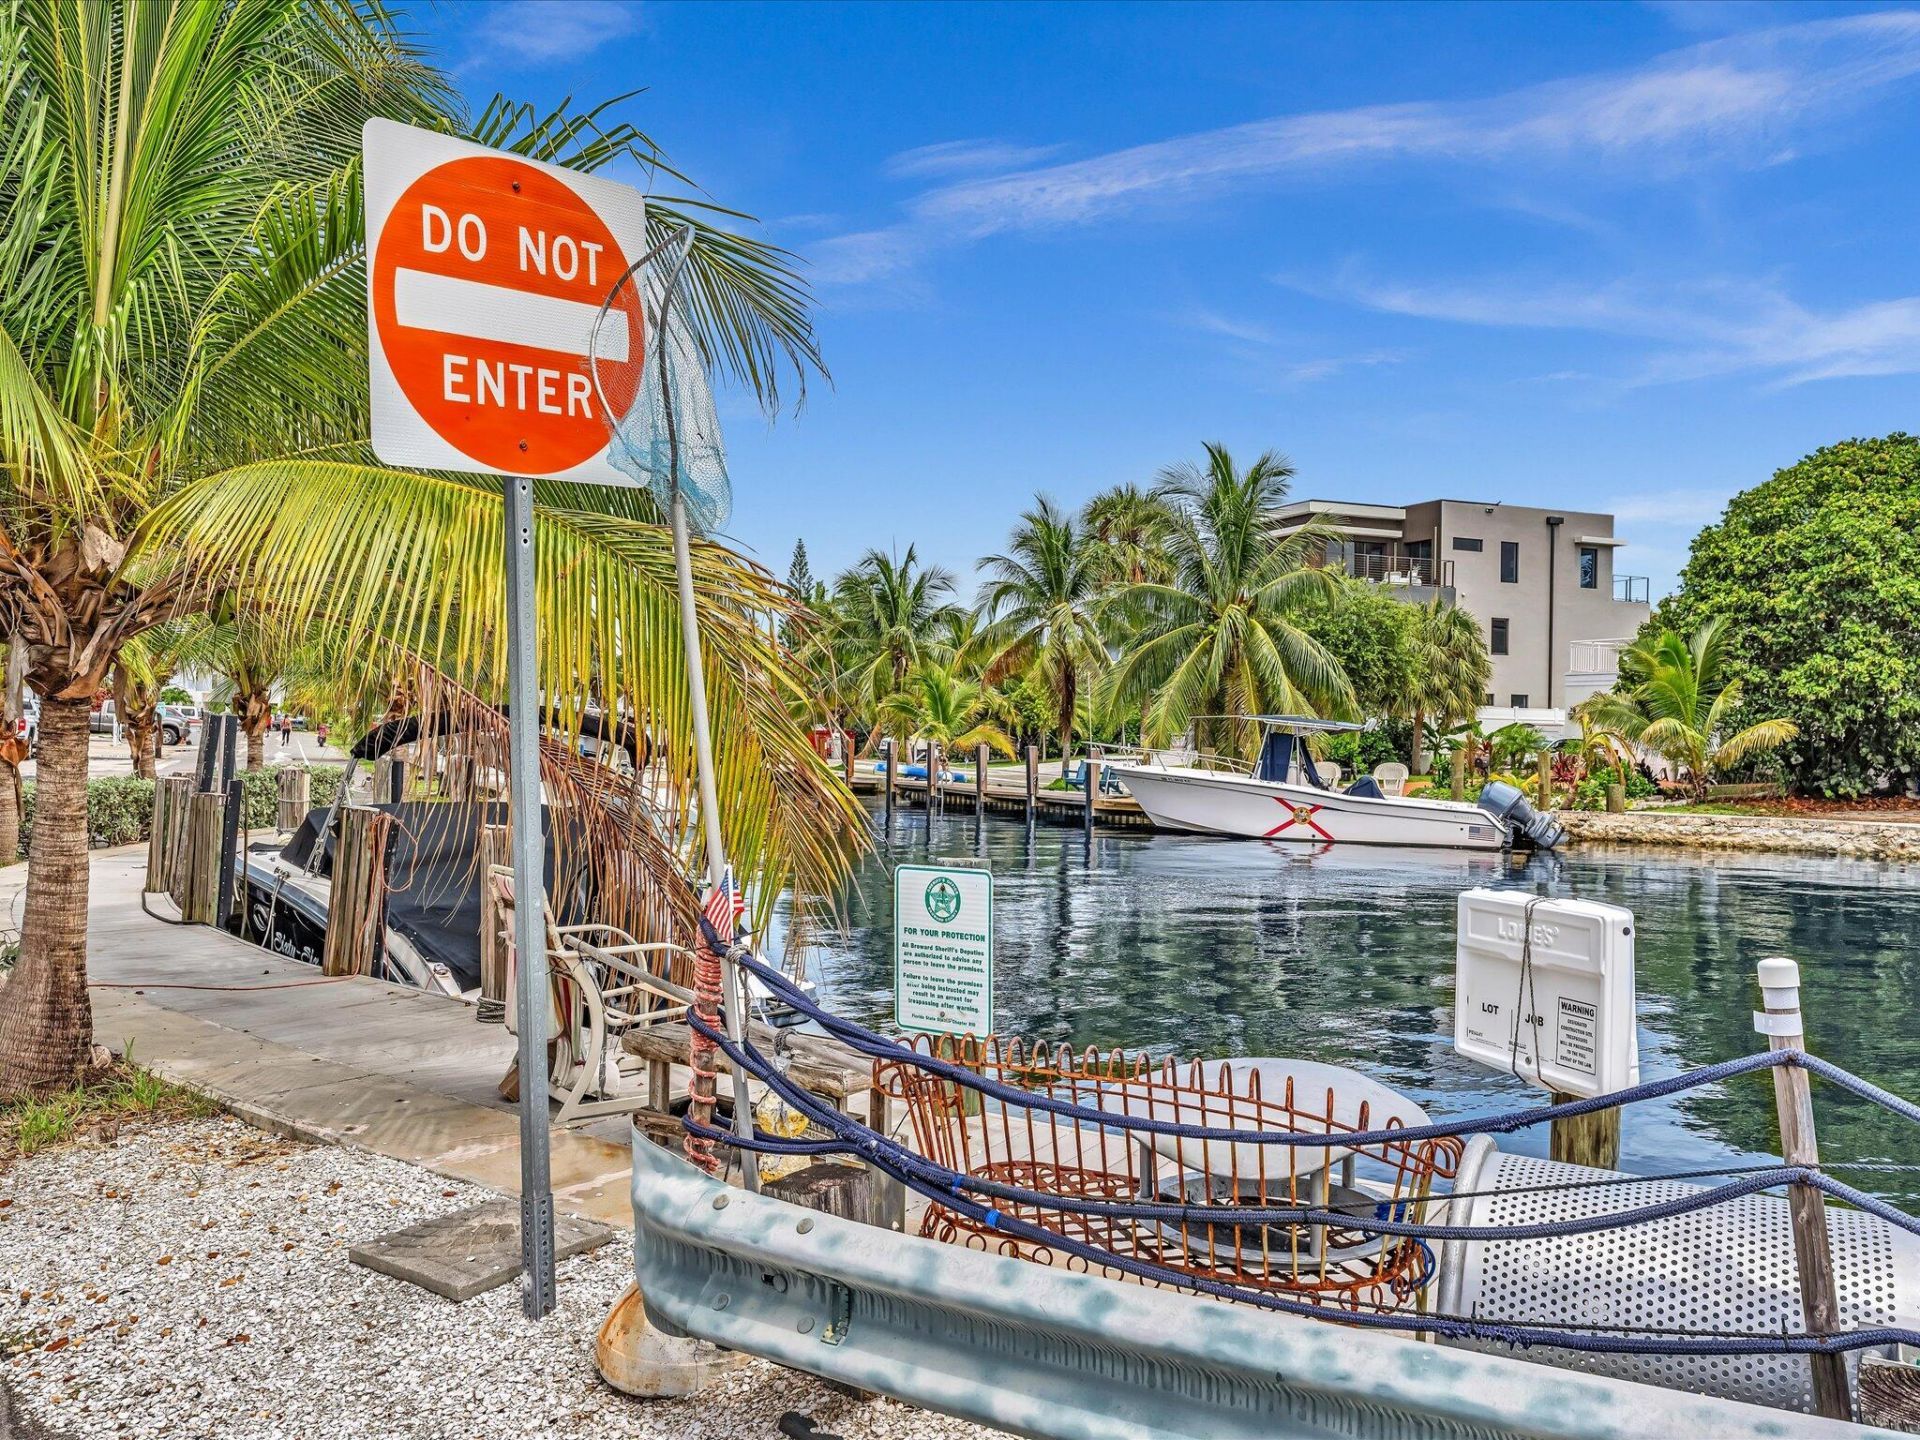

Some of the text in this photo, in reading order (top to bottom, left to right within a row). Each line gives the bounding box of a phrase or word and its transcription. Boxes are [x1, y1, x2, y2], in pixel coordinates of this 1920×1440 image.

[421, 203, 604, 287] DO NOT
[442, 353, 594, 419] ENTER
[904, 926, 986, 942] FOR YOUR PROTECTION
[910, 942, 934, 951] Broward
[935, 946, 958, 954] Sheriff's
[960, 948, 984, 956] Deputies
[914, 952, 942, 960] authorized
[952, 956, 970, 964] advise
[972, 958, 982, 966] any
[958, 965, 985, 974] premises.
[902, 972, 921, 980] Failure
[958, 980, 983, 988] premises
[921, 983, 936, 991] being
[938, 985, 966, 994] instructed
[908, 997, 940, 1008] trespassing
[940, 1002, 954, 1010] after
[1481, 1002, 1500, 1016] LOT
[1561, 1001, 1595, 1017] WARNING
[1524, 1013, 1545, 1027] JOB
